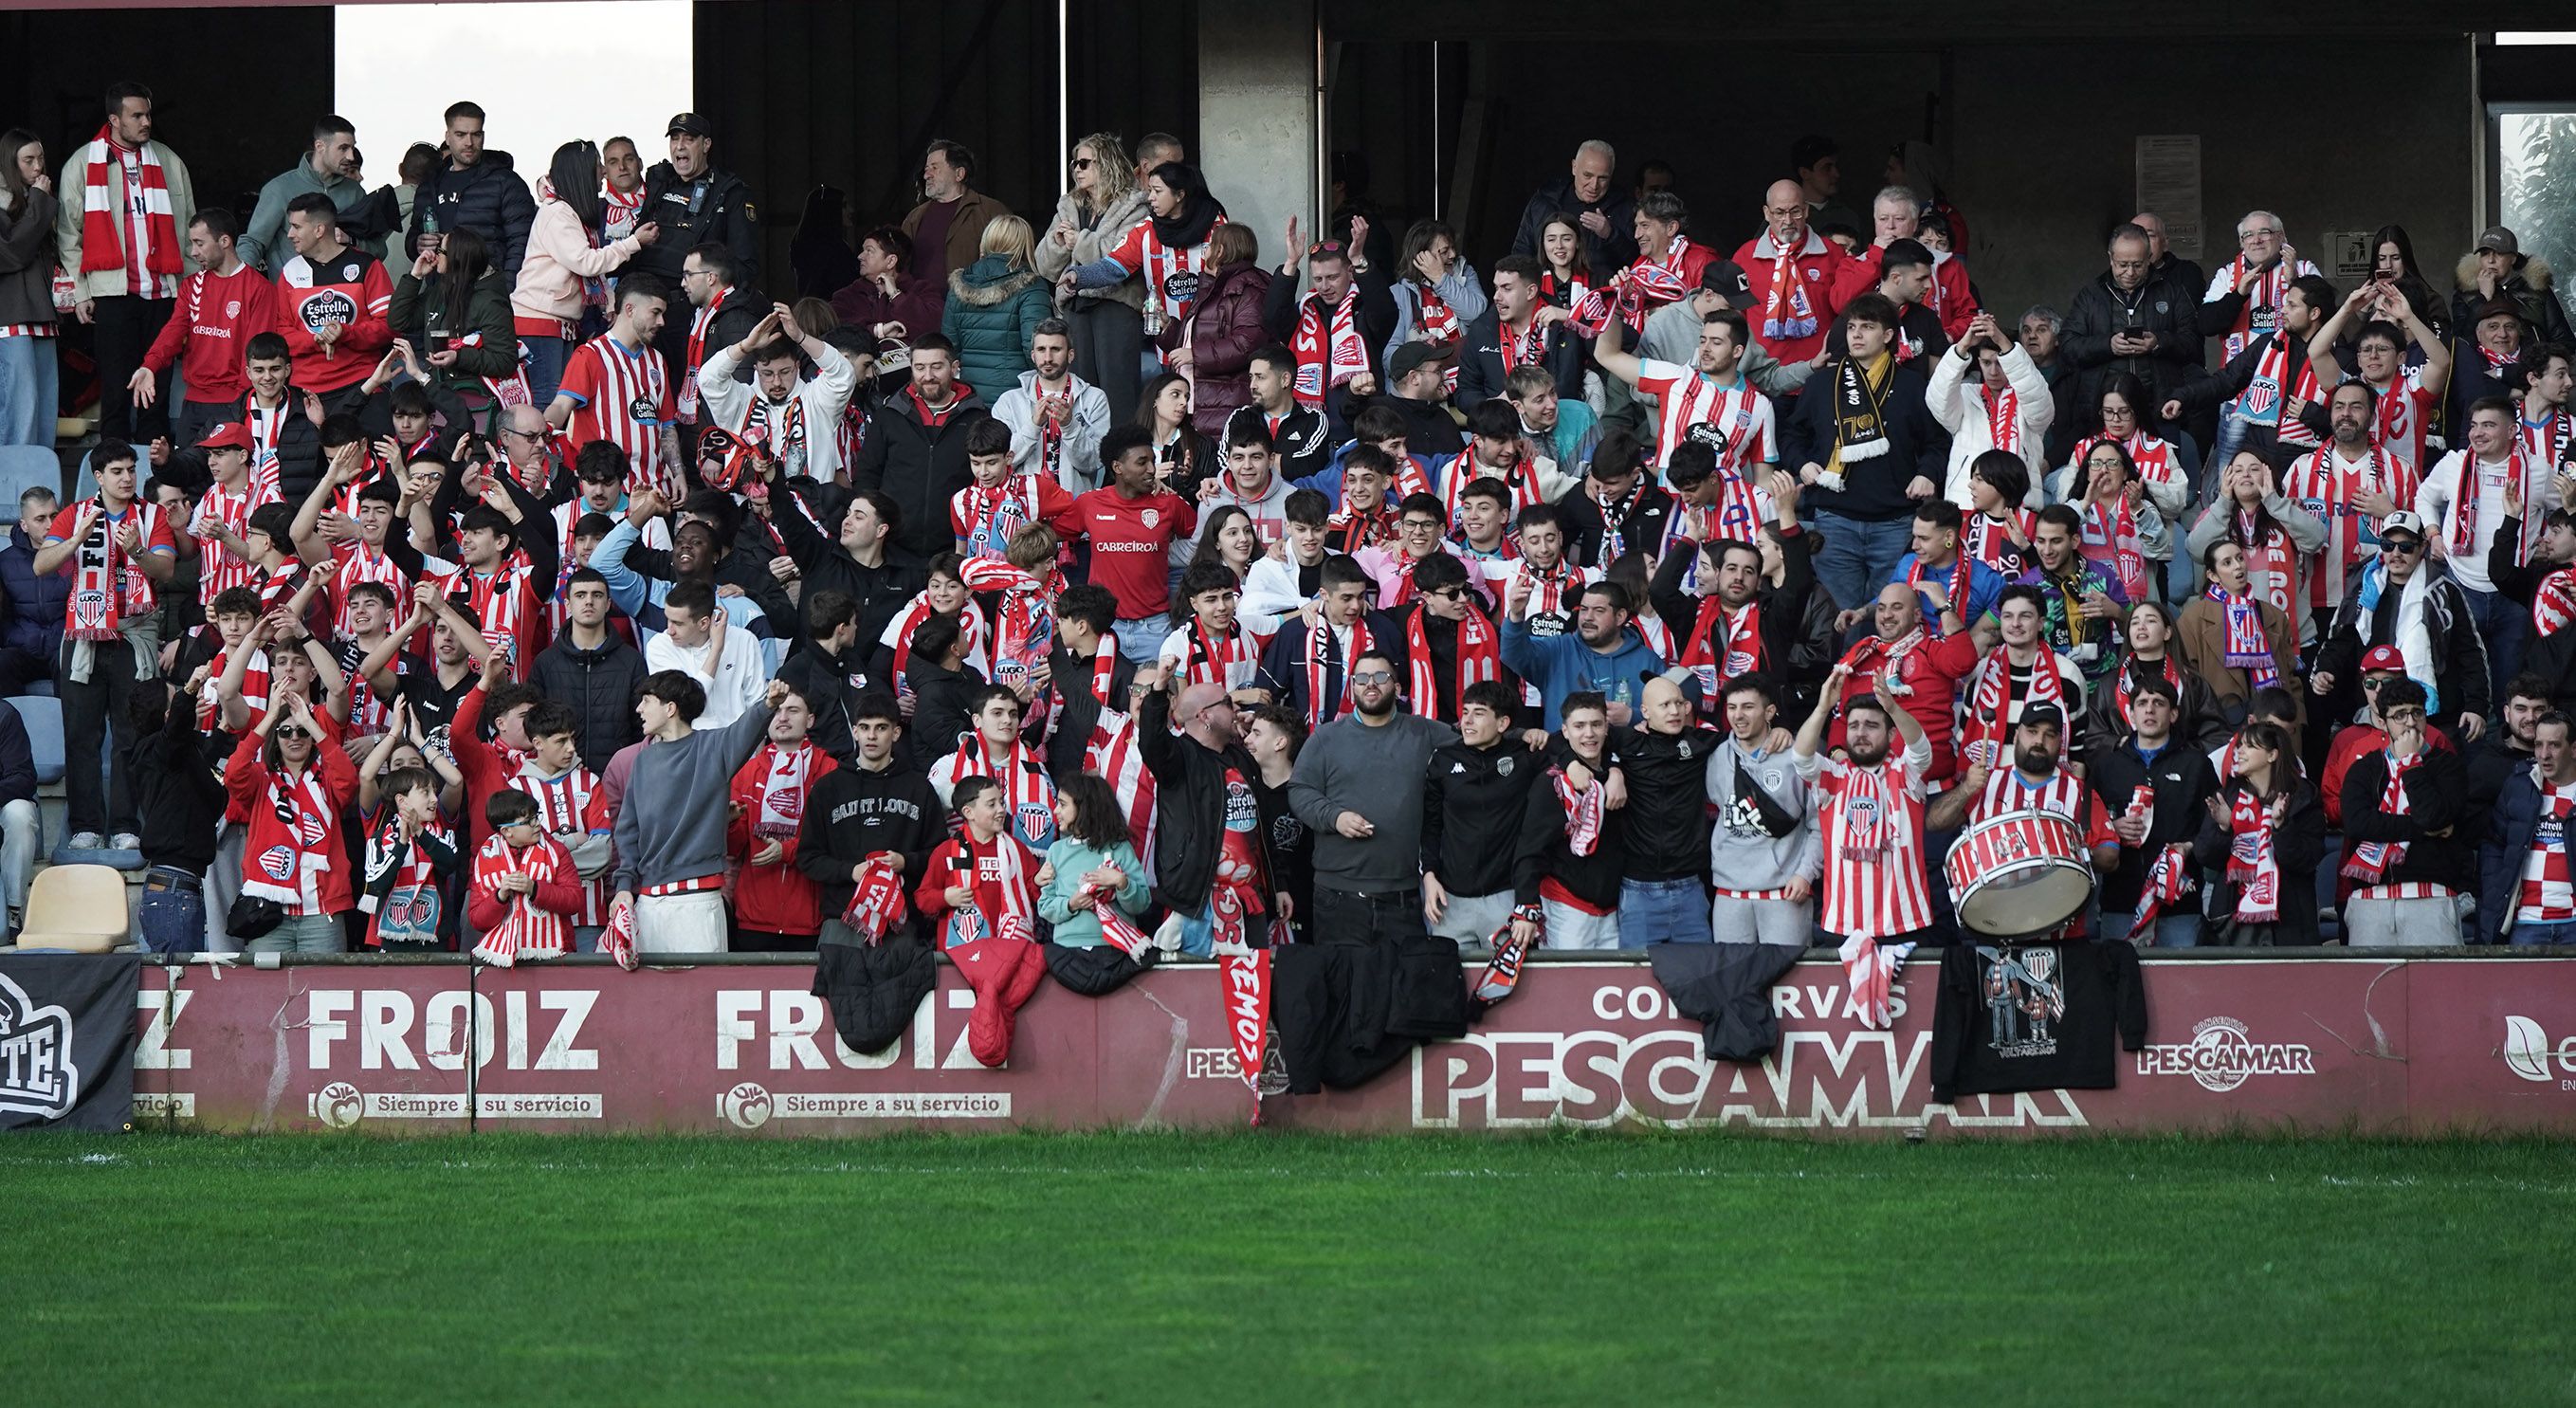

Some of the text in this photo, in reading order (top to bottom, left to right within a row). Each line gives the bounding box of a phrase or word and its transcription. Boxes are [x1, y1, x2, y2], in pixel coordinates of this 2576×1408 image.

[306, 301, 349, 317] Estrella
[2252, 320, 2275, 328] Galici
[2252, 380, 2276, 390] LUGO
[1692, 426, 1724, 444] Estrella
[1531, 617, 1564, 630] Estrella
[996, 666, 1024, 675] LUGO
[1019, 808, 1049, 817] LUGO
[1851, 802, 1874, 811] LUGO
[1592, 985, 1908, 1020] CORVS
[309, 990, 600, 1070] FROIZ
[2137, 1044, 2316, 1075] PESCAMAR
[1412, 1031, 2090, 1128] PESCAM
[378, 1095, 458, 1114] Siempre
[484, 1100, 505, 1111] su
[513, 1096, 592, 1112] servicio
[787, 1096, 999, 1115] Siempre a su servicio
